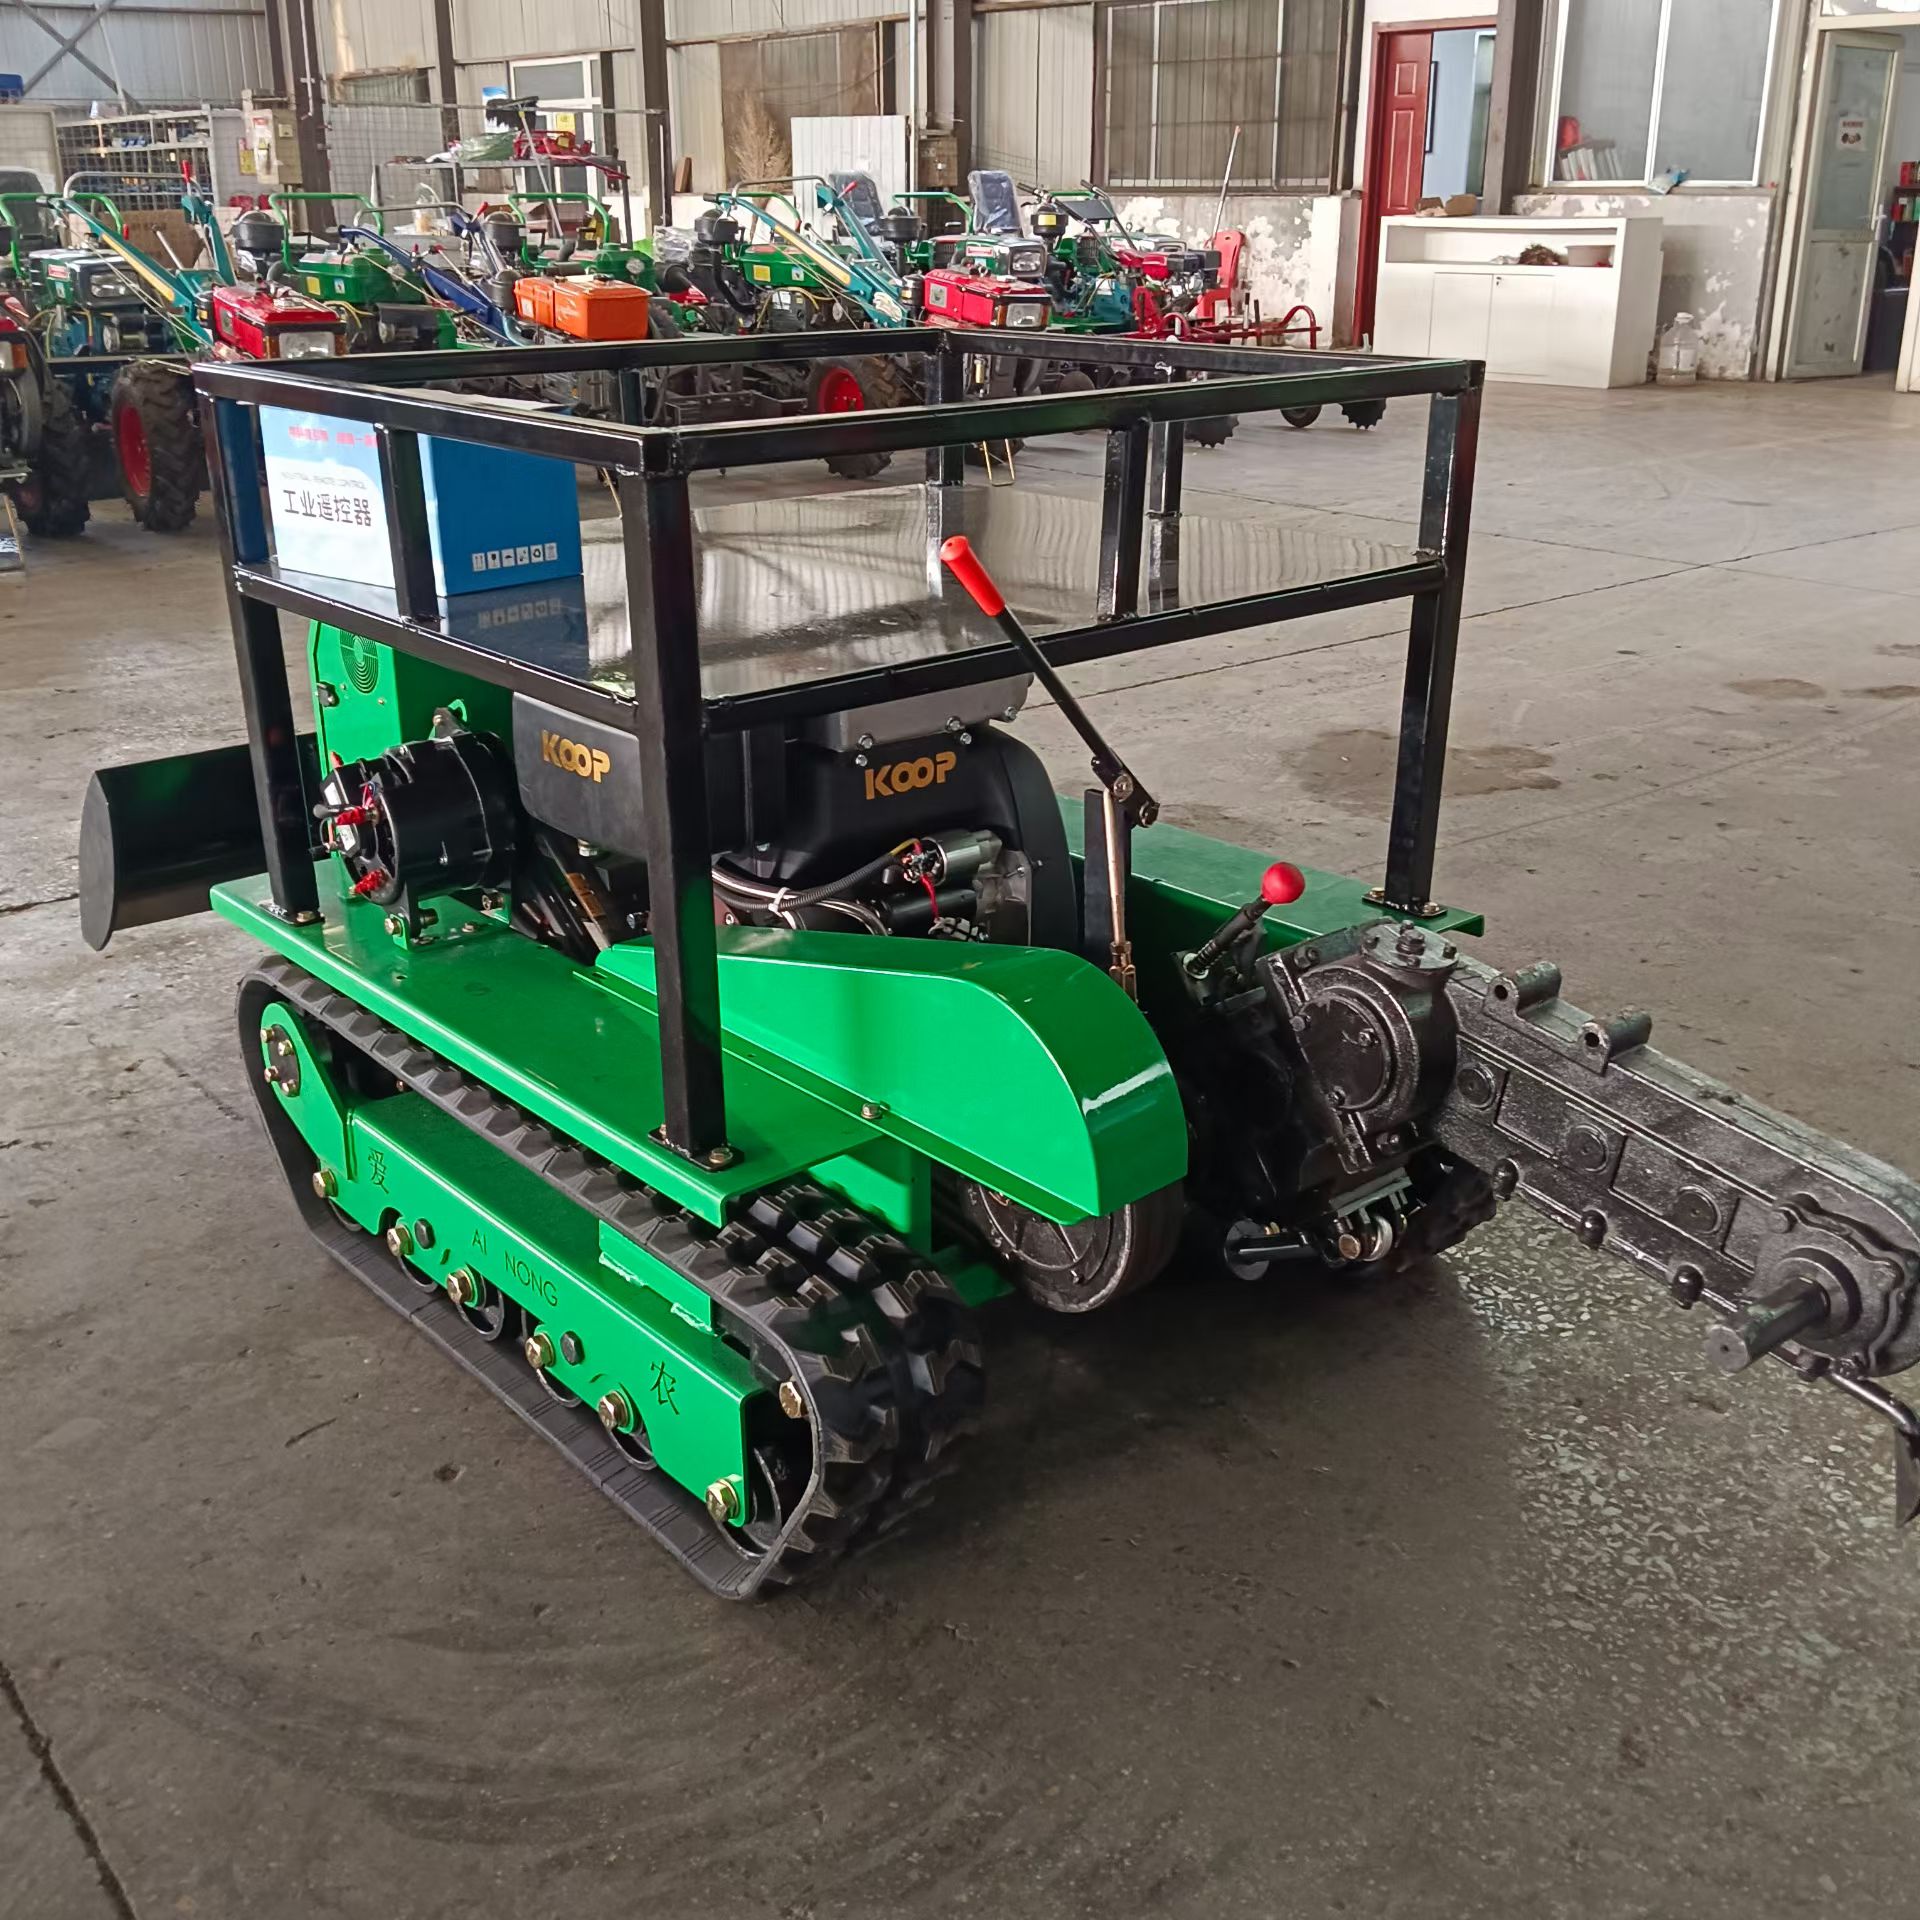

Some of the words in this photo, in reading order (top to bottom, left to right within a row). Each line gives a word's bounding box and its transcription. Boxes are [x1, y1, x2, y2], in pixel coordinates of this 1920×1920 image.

[283, 489, 372, 527] 工业遥控器
[542, 729, 611, 783] KOOP
[864, 751, 957, 800] KOOP
[472, 1229, 487, 1256] AI
[504, 1250, 558, 1307] NONG
[650, 1361, 680, 1415] 农
